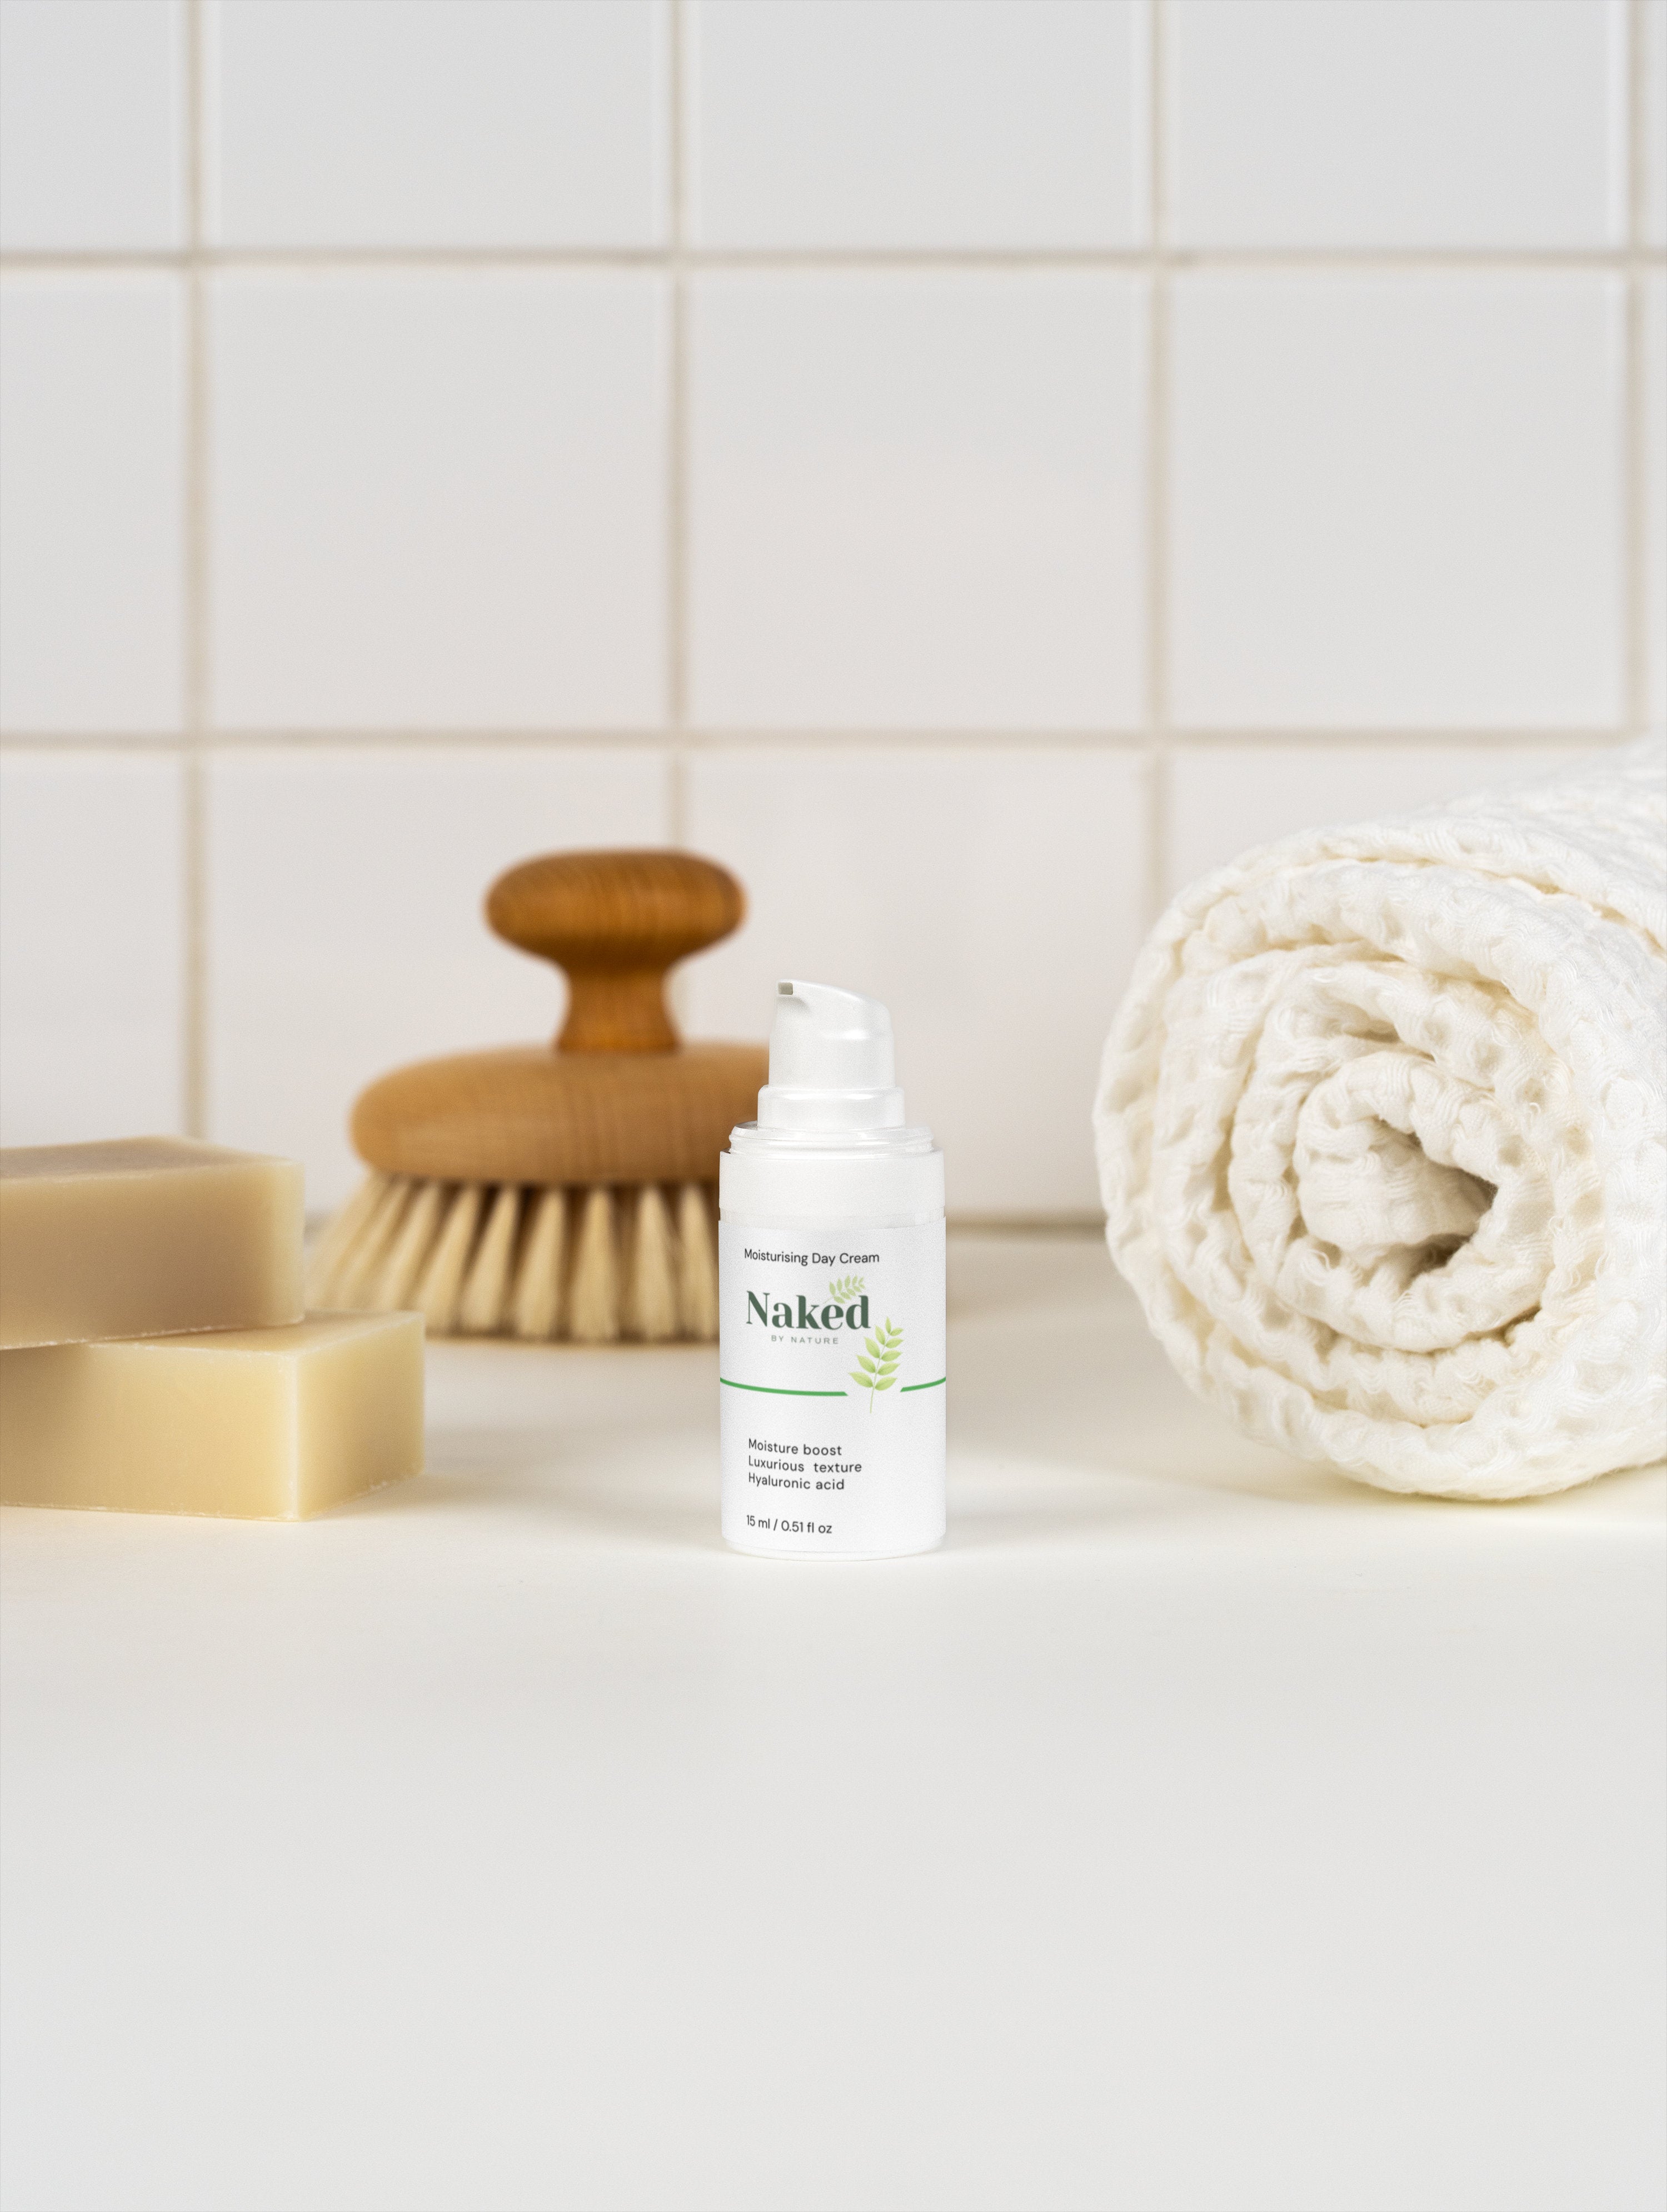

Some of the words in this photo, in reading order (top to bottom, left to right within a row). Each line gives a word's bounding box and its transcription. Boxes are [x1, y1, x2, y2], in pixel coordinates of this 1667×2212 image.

[744, 1248, 808, 1267] Moisturising
[812, 1252, 836, 1267] Day
[839, 1252, 880, 1264] Cream
[746, 1291, 871, 1331] Naked
[791, 1336, 839, 1345] NATURE
[748, 1438, 798, 1454] Moisture
[803, 1444, 842, 1456] boost
[748, 1455, 805, 1472] Luxurious
[813, 1463, 862, 1473] texture
[748, 1472, 810, 1489] Hyaluronic
[816, 1479, 845, 1490] acid
[747, 1514, 755, 1527] 15
[758, 1518, 770, 1529] ml
[773, 1519, 778, 1531] /
[781, 1520, 803, 1532] 0.51
[807, 1522, 814, 1533] fl
[818, 1525, 832, 1533] oz
